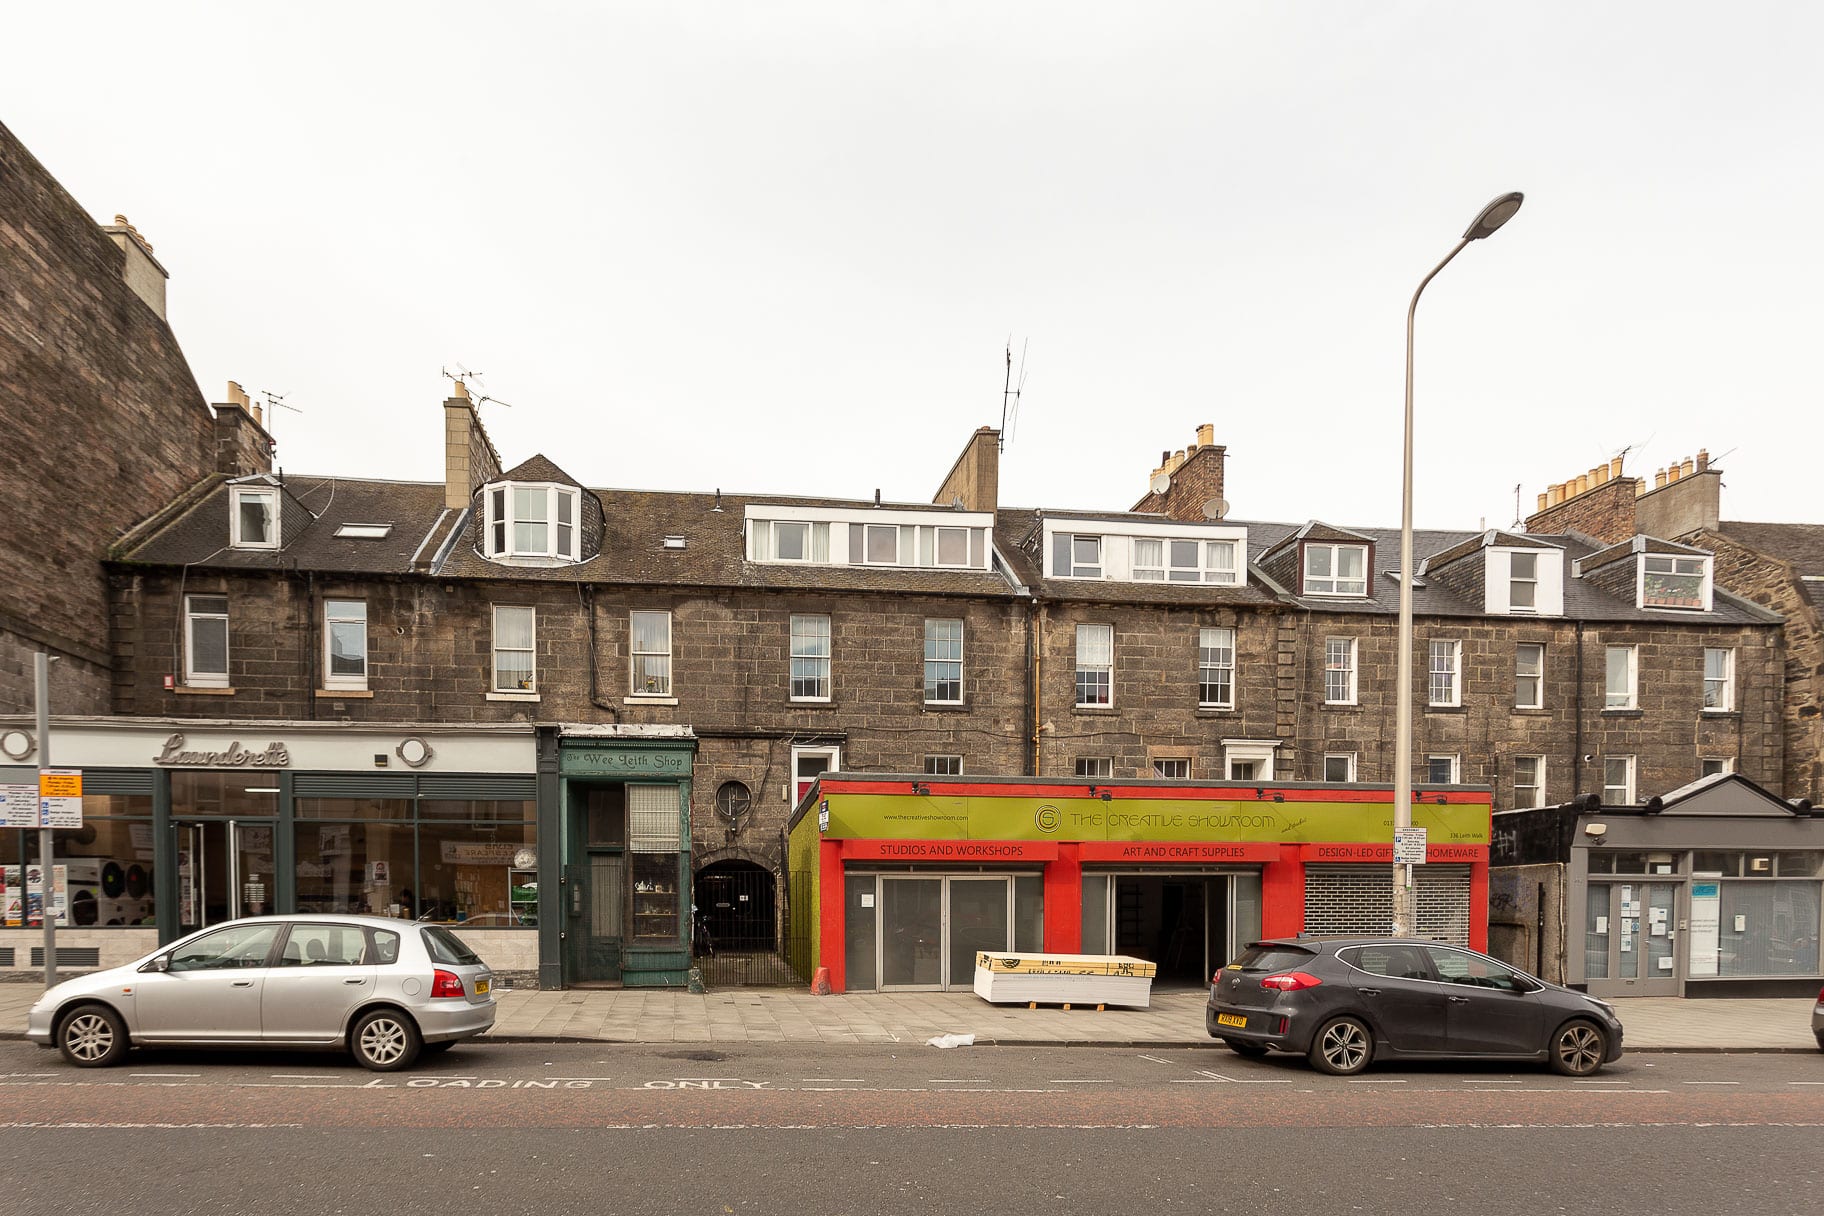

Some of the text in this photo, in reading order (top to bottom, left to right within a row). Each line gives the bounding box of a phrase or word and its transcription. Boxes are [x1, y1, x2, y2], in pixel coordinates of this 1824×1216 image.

[152, 733, 289, 767] Launderette
[583, 754, 614, 766] Wee
[619, 754, 648, 769] Leith
[653, 755, 683, 770] Shop
[884, 814, 969, 822] www.thecreativeshowroom.com
[1070, 813, 1276, 828] THE CREATIVE SHOWROOM
[880, 844, 1023, 857] STUDIOS AND WORKSHOPS
[1122, 847, 1245, 857] ART AND CRAFT SUPPLIES
[1426, 848, 1479, 858] HOMEWARE
[362, 1079, 771, 1090] LOADING ONLY
